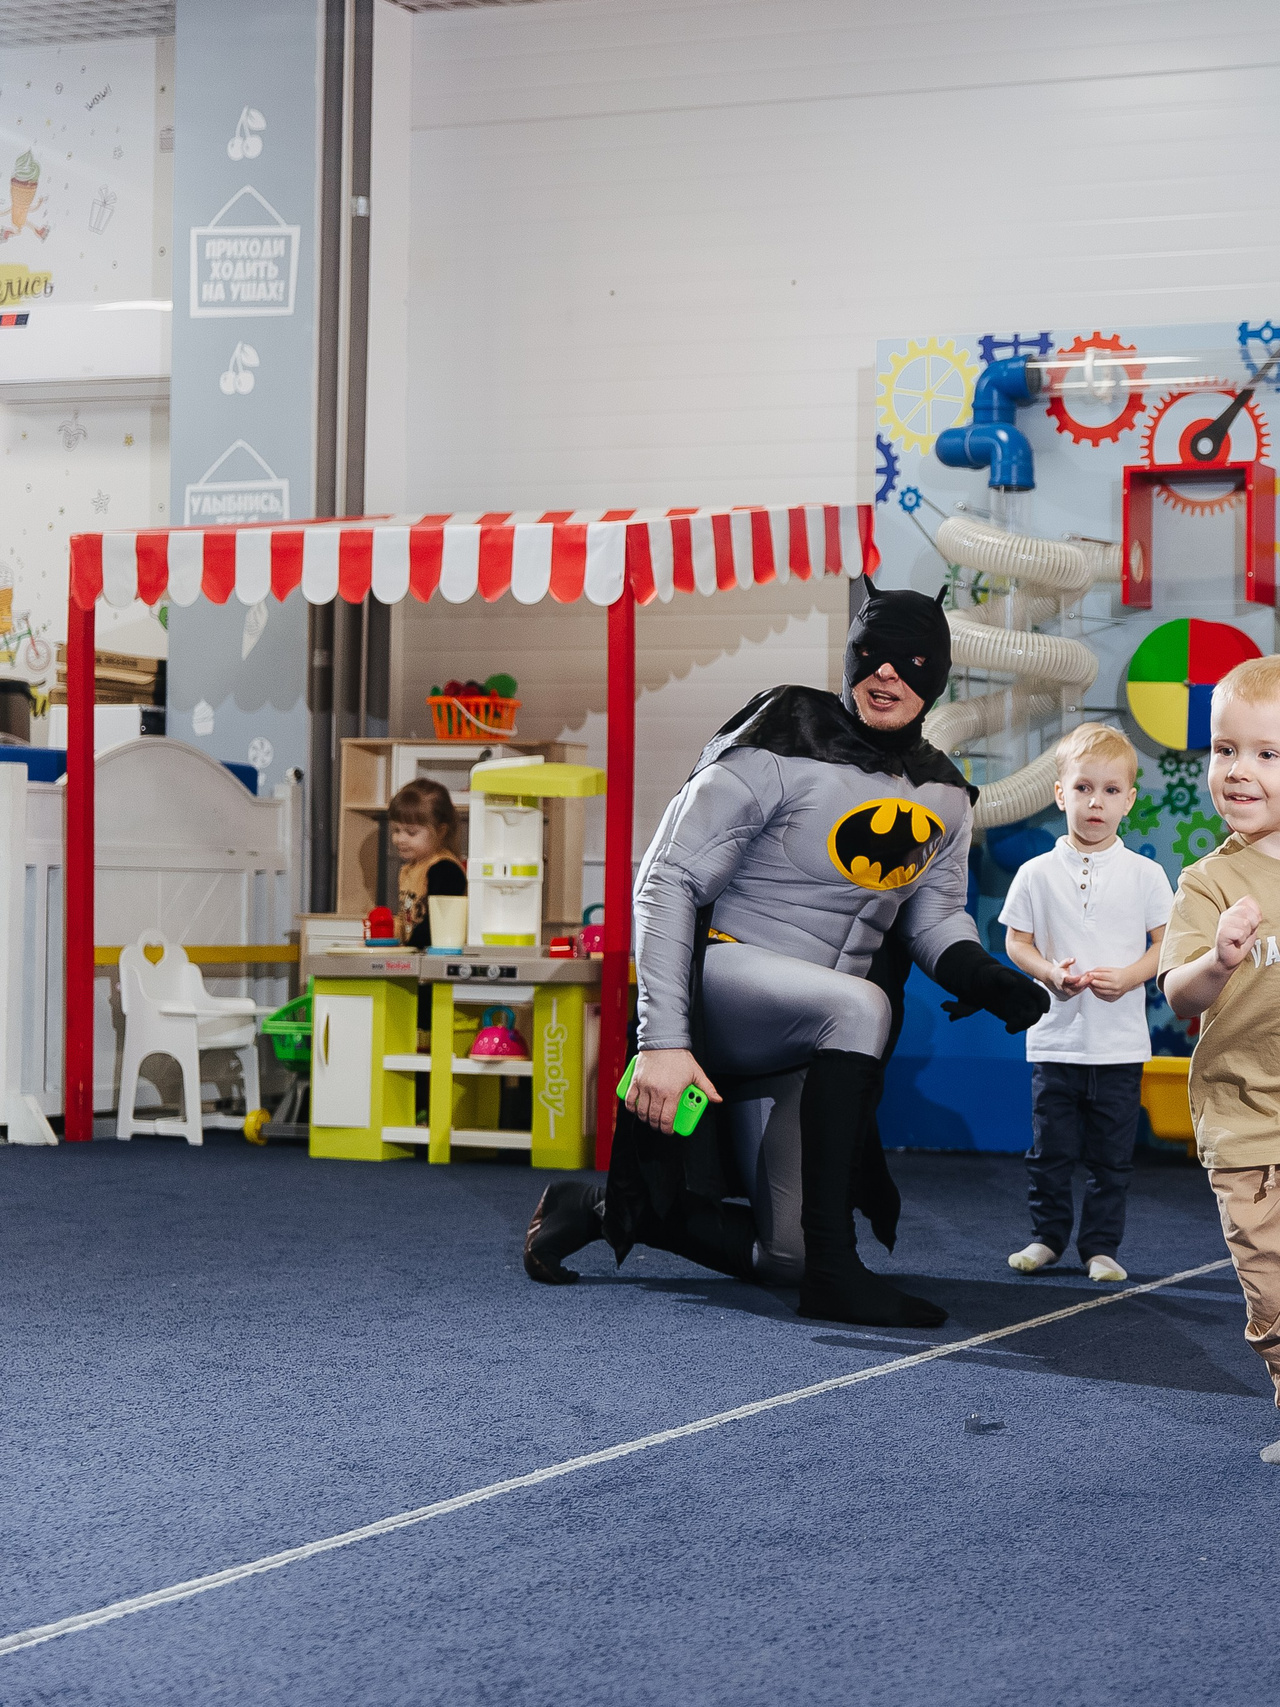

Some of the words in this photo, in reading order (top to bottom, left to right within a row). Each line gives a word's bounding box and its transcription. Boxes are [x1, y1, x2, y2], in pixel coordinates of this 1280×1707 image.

[205, 238, 285, 259] ПРИХОДИ
[210, 260, 279, 280] ХОДИТЬ
[202, 281, 225, 302] НА
[230, 280, 285, 302] УШАХ!
[538, 1022, 570, 1118] Smoby
